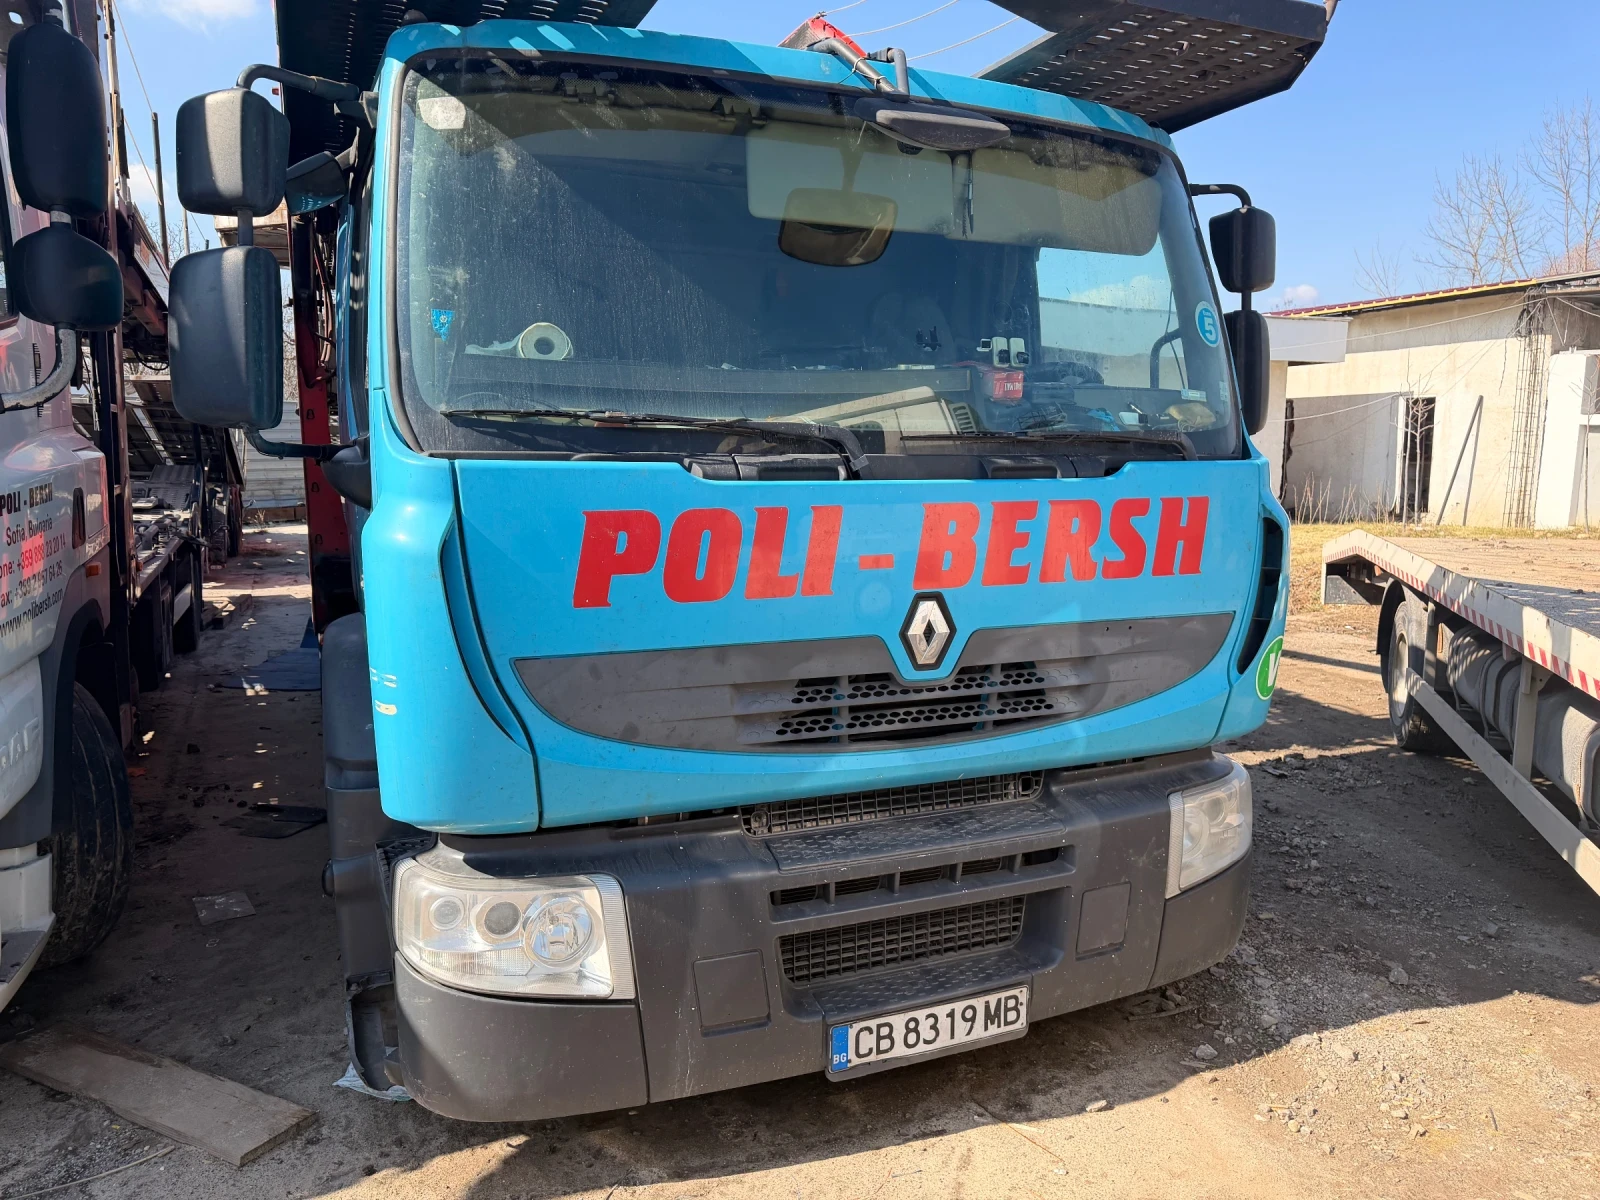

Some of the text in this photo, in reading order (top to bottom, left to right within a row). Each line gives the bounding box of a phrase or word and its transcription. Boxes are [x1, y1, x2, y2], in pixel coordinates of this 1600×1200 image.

[1204, 316, 1217, 341] 5
[0, 491, 22, 517] POLI
[28, 483, 53, 508] BERSH
[6, 513, 53, 547] Sofia, Bulgaria
[16, 548, 34, 572] +359
[572, 495, 1210, 610] POLI - BERSH
[854, 994, 1021, 1060] CB 8319 MB
[832, 1053, 847, 1065] BG
